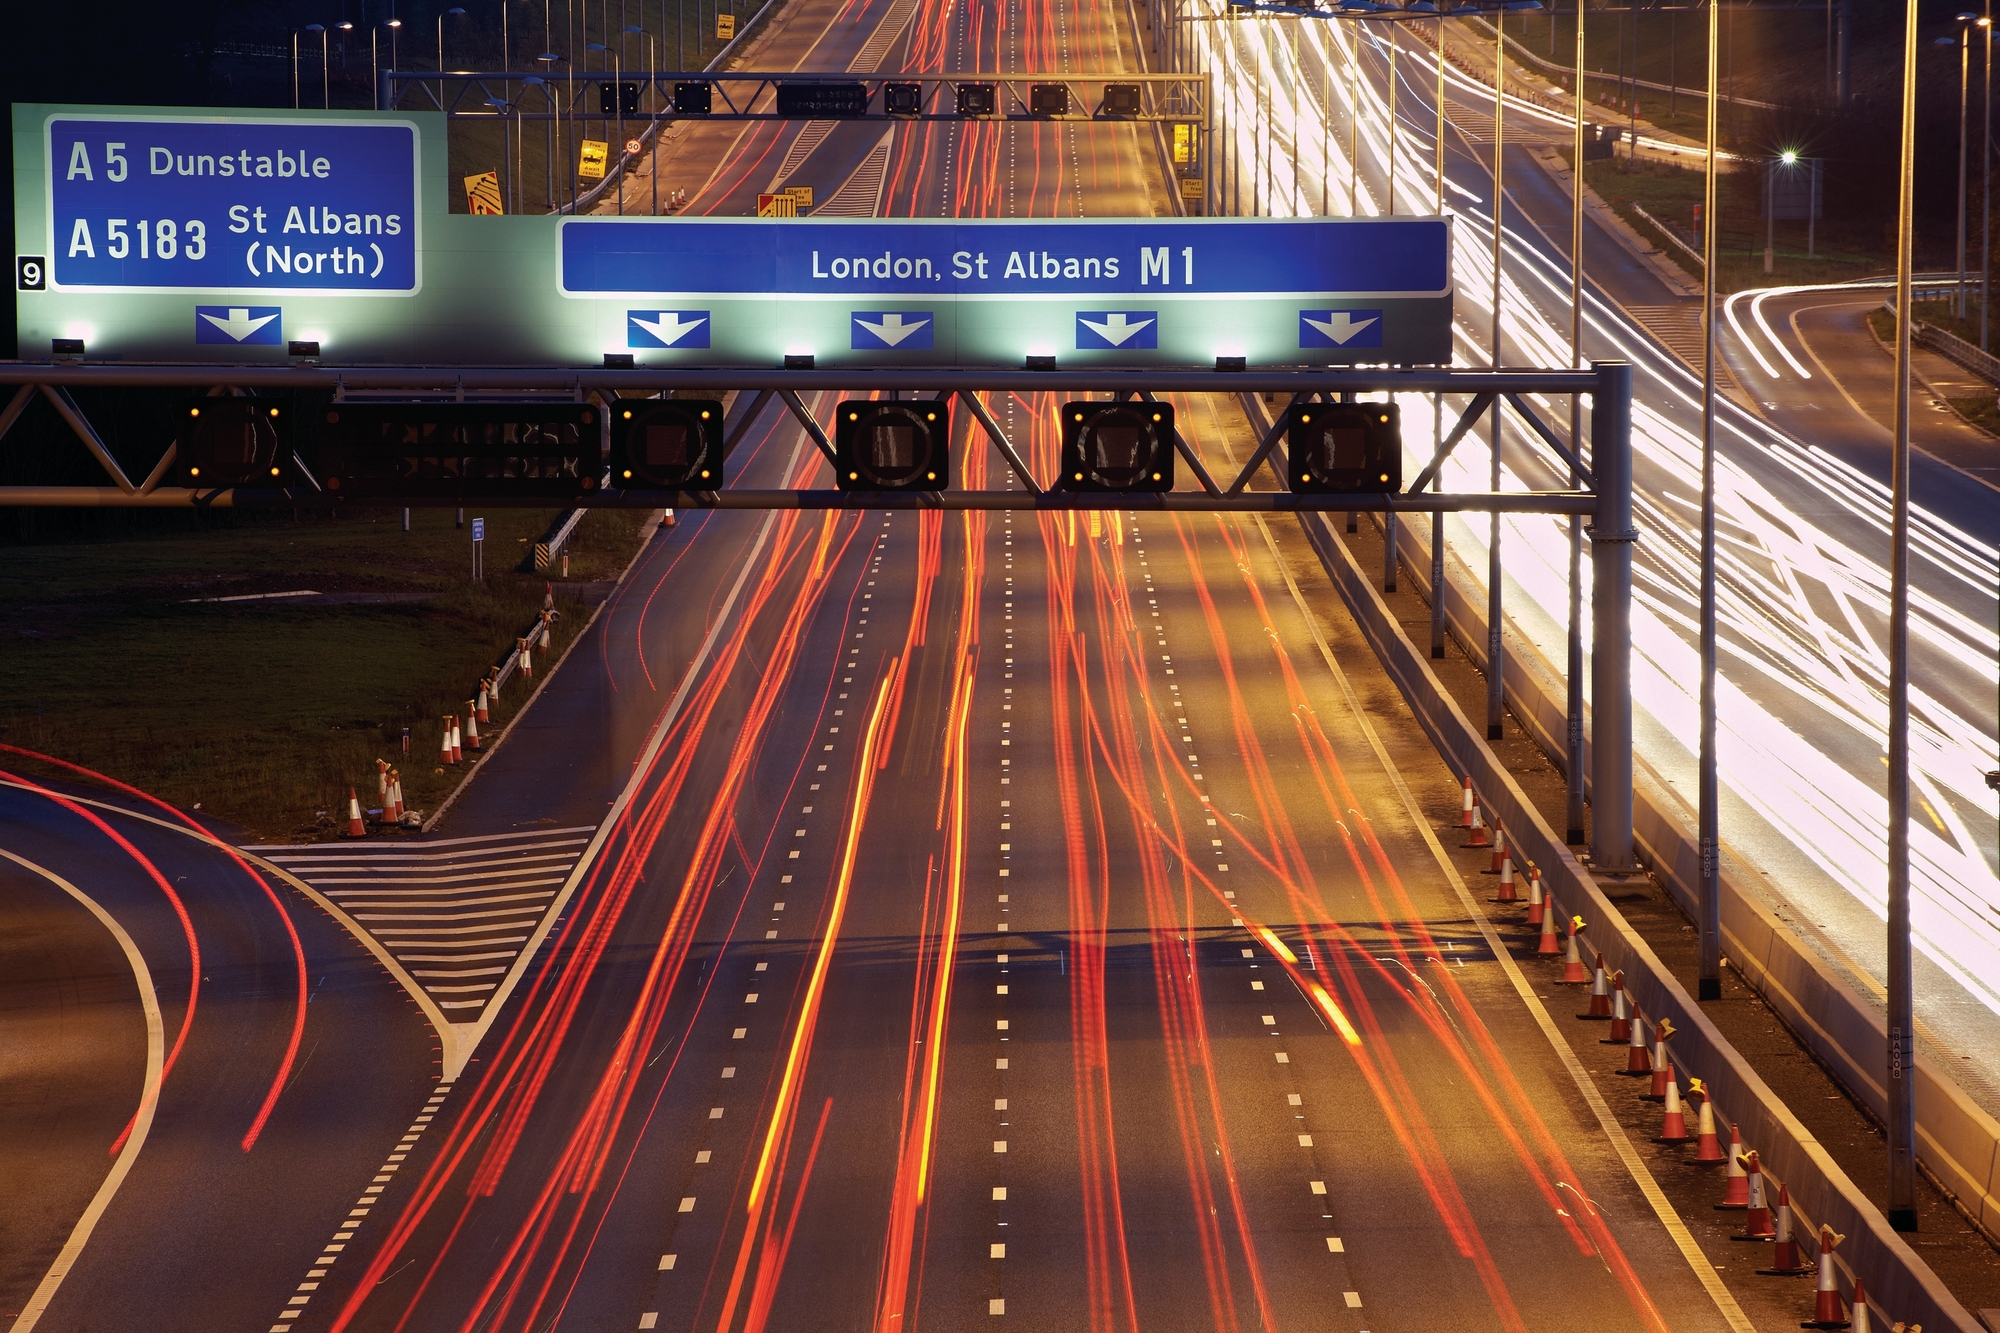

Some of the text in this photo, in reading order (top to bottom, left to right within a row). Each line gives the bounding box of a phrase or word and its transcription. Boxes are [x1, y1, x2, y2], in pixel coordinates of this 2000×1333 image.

[149, 147, 331, 179] Dunstable
[228, 204, 402, 236] St Albans
[23, 262, 41, 286] 9
[246, 238, 384, 279] (North)
[812, 250, 942, 282] London,
[951, 251, 989, 280] St
[1003, 251, 1120, 279] Albans
[1893, 1033, 1901, 1077] BA008
